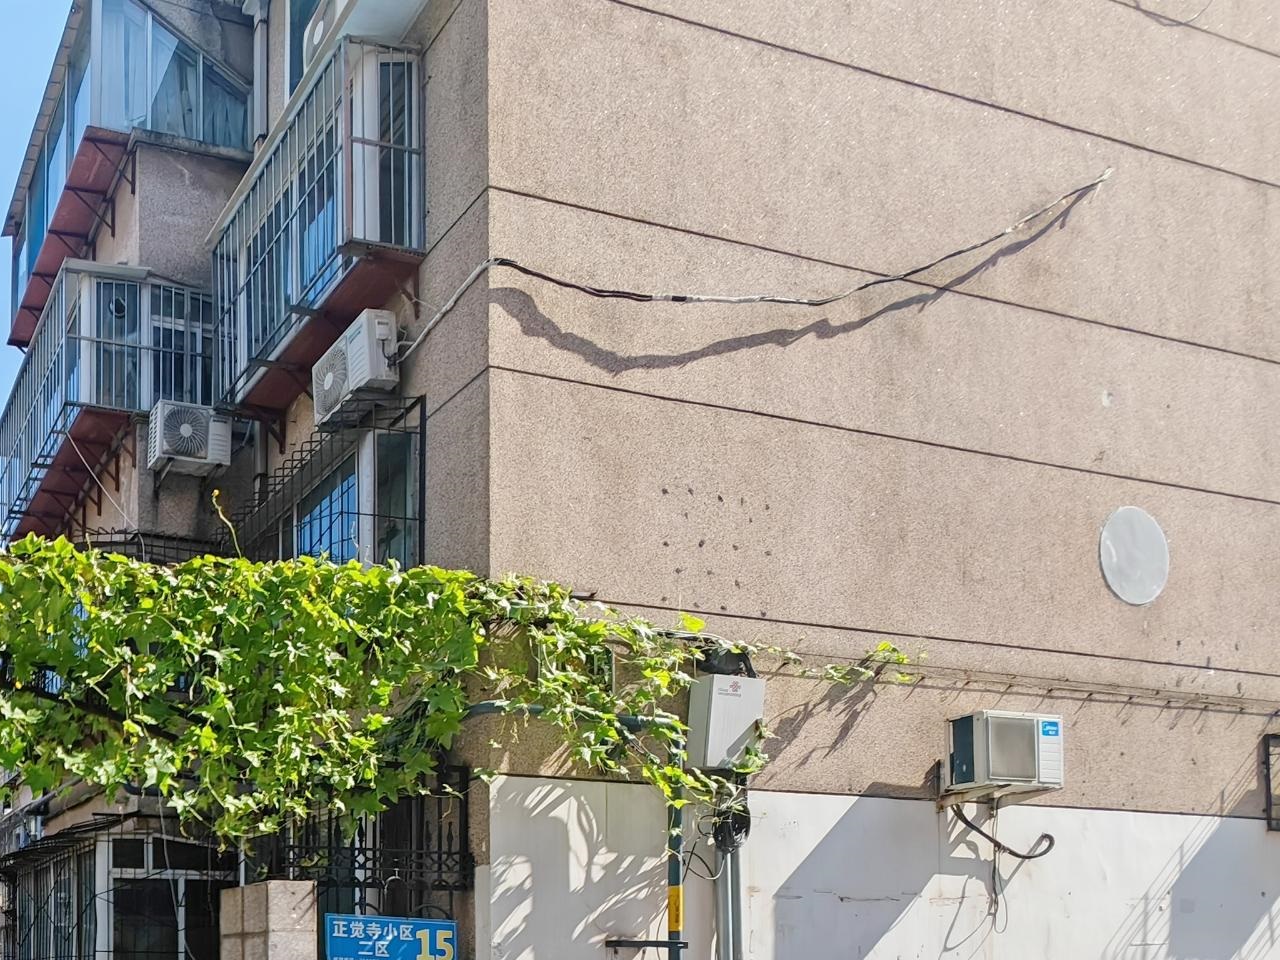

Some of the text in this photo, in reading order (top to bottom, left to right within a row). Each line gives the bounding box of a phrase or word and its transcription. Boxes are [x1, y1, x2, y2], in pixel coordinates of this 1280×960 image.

[332, 920, 414, 940] 正觉寺小区
[358, 941, 390, 957] 二区
